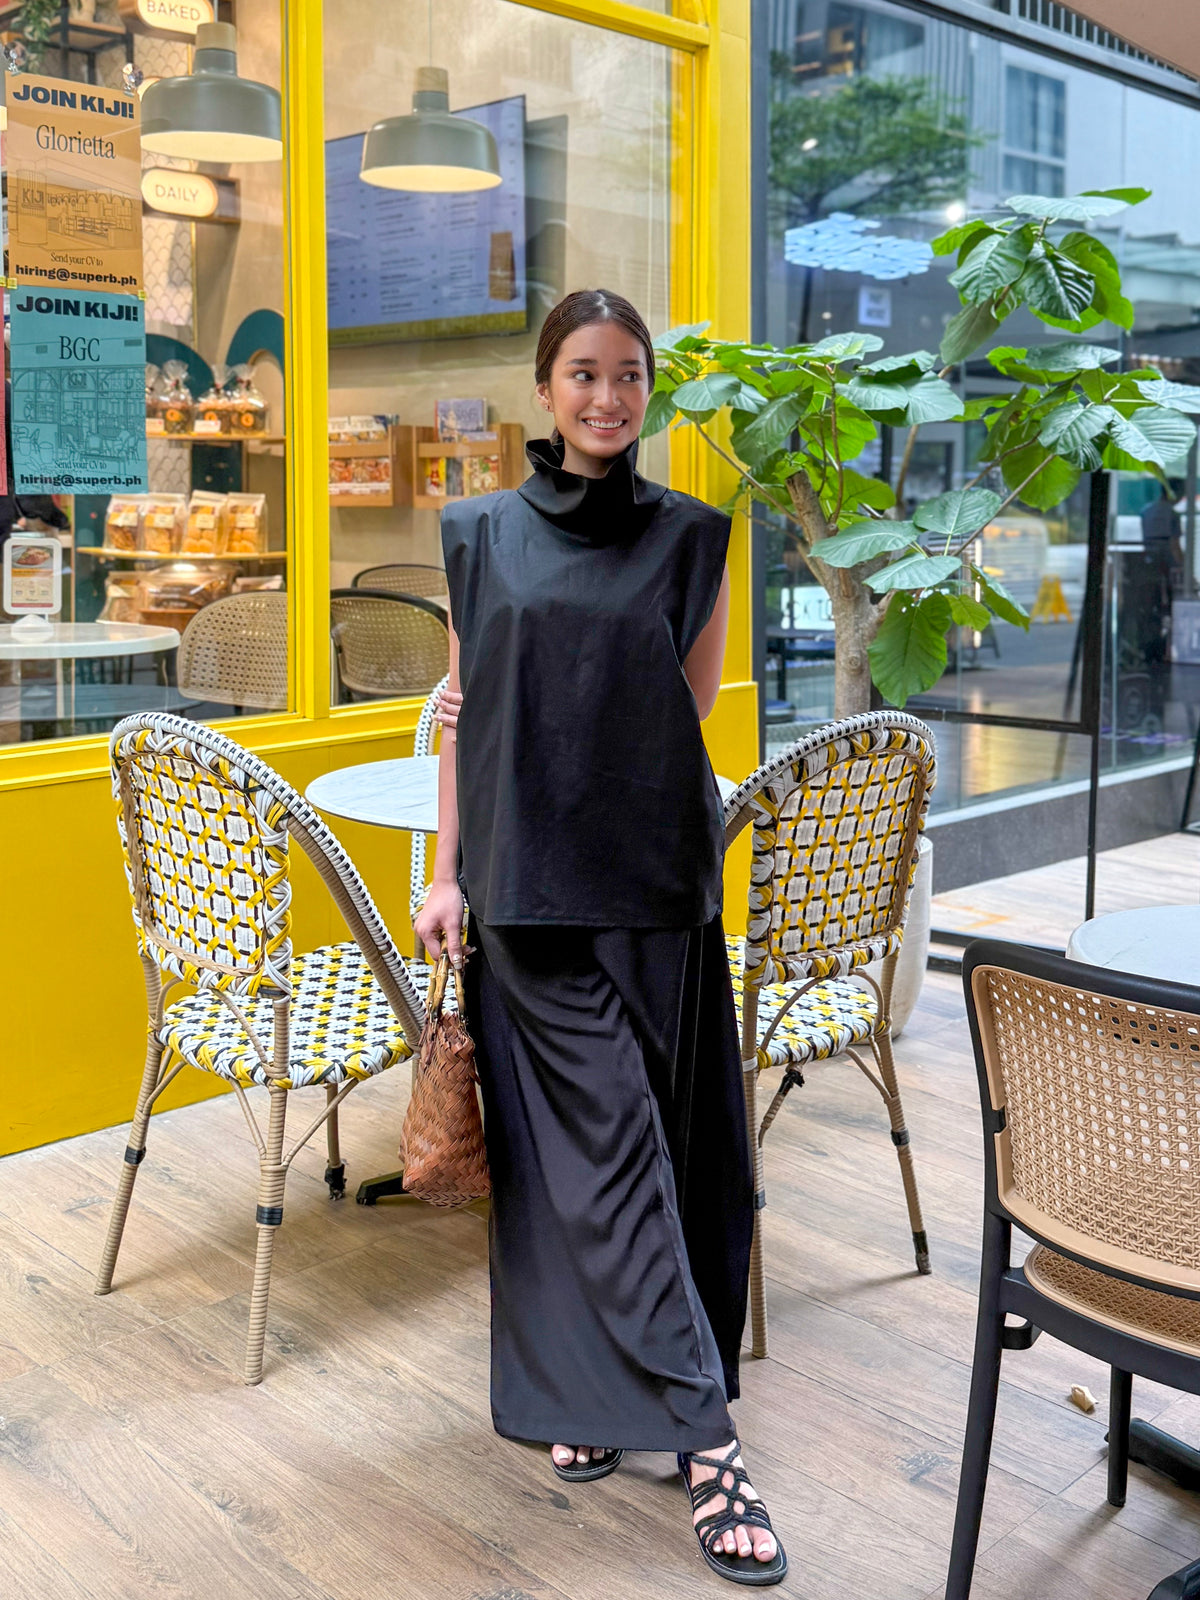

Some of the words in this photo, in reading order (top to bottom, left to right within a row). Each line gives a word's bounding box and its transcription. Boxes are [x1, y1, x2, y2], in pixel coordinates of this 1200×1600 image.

[147, 0, 201, 21] BAKED
[12, 84, 77, 109] JOIN
[80, 94, 134, 119] KIJI!
[36, 124, 116, 159] Glorietta
[155, 184, 200, 202] DAILY
[50, 252, 69, 264] Send
[69, 255, 85, 266] your
[85, 255, 96, 266] CV
[95, 257, 104, 267] to
[15, 264, 138, 286] hiring@superb.ph
[16, 295, 81, 316] JOIN
[84, 301, 139, 322] KIJI!
[59, 335, 101, 362] BGC
[54, 460, 72, 470] Send
[71, 461, 88, 473] your
[98, 461, 107, 470] to
[20, 474, 142, 487] hiring@superb.ph
